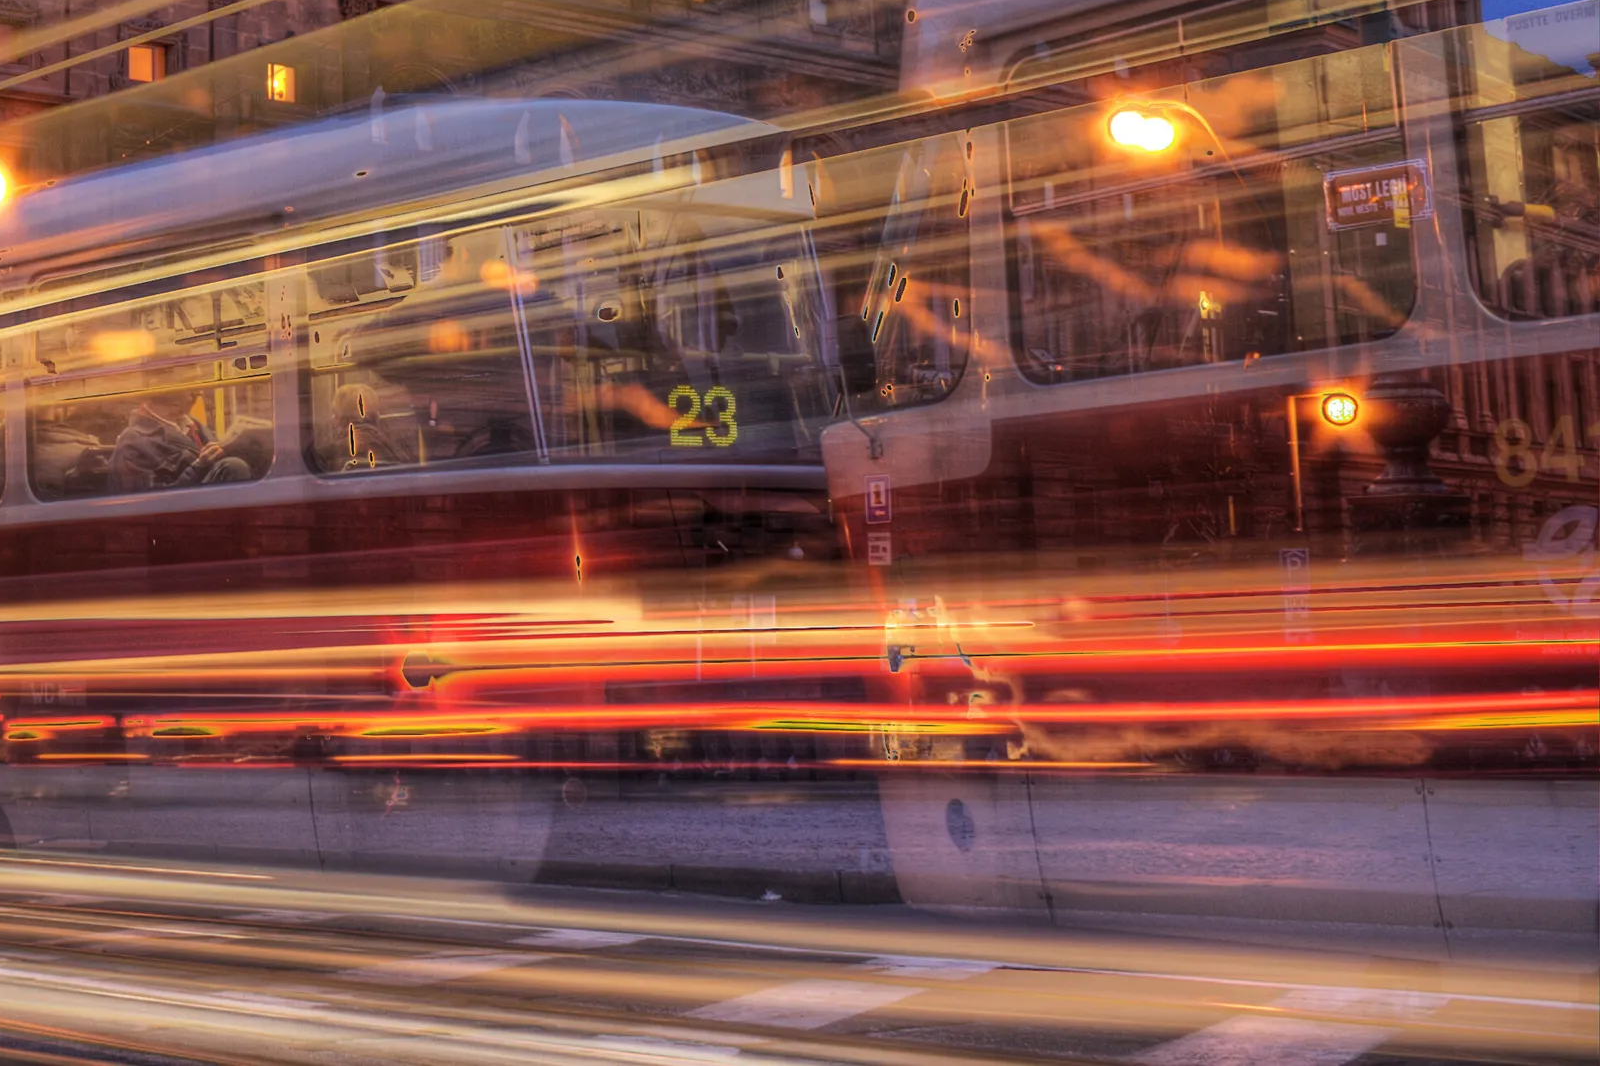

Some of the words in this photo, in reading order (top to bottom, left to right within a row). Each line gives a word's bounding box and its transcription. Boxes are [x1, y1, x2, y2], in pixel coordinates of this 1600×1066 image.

[1339, 181, 1372, 203] MOST
[668, 385, 738, 446] 23
[1495, 414, 1600, 487] 84
